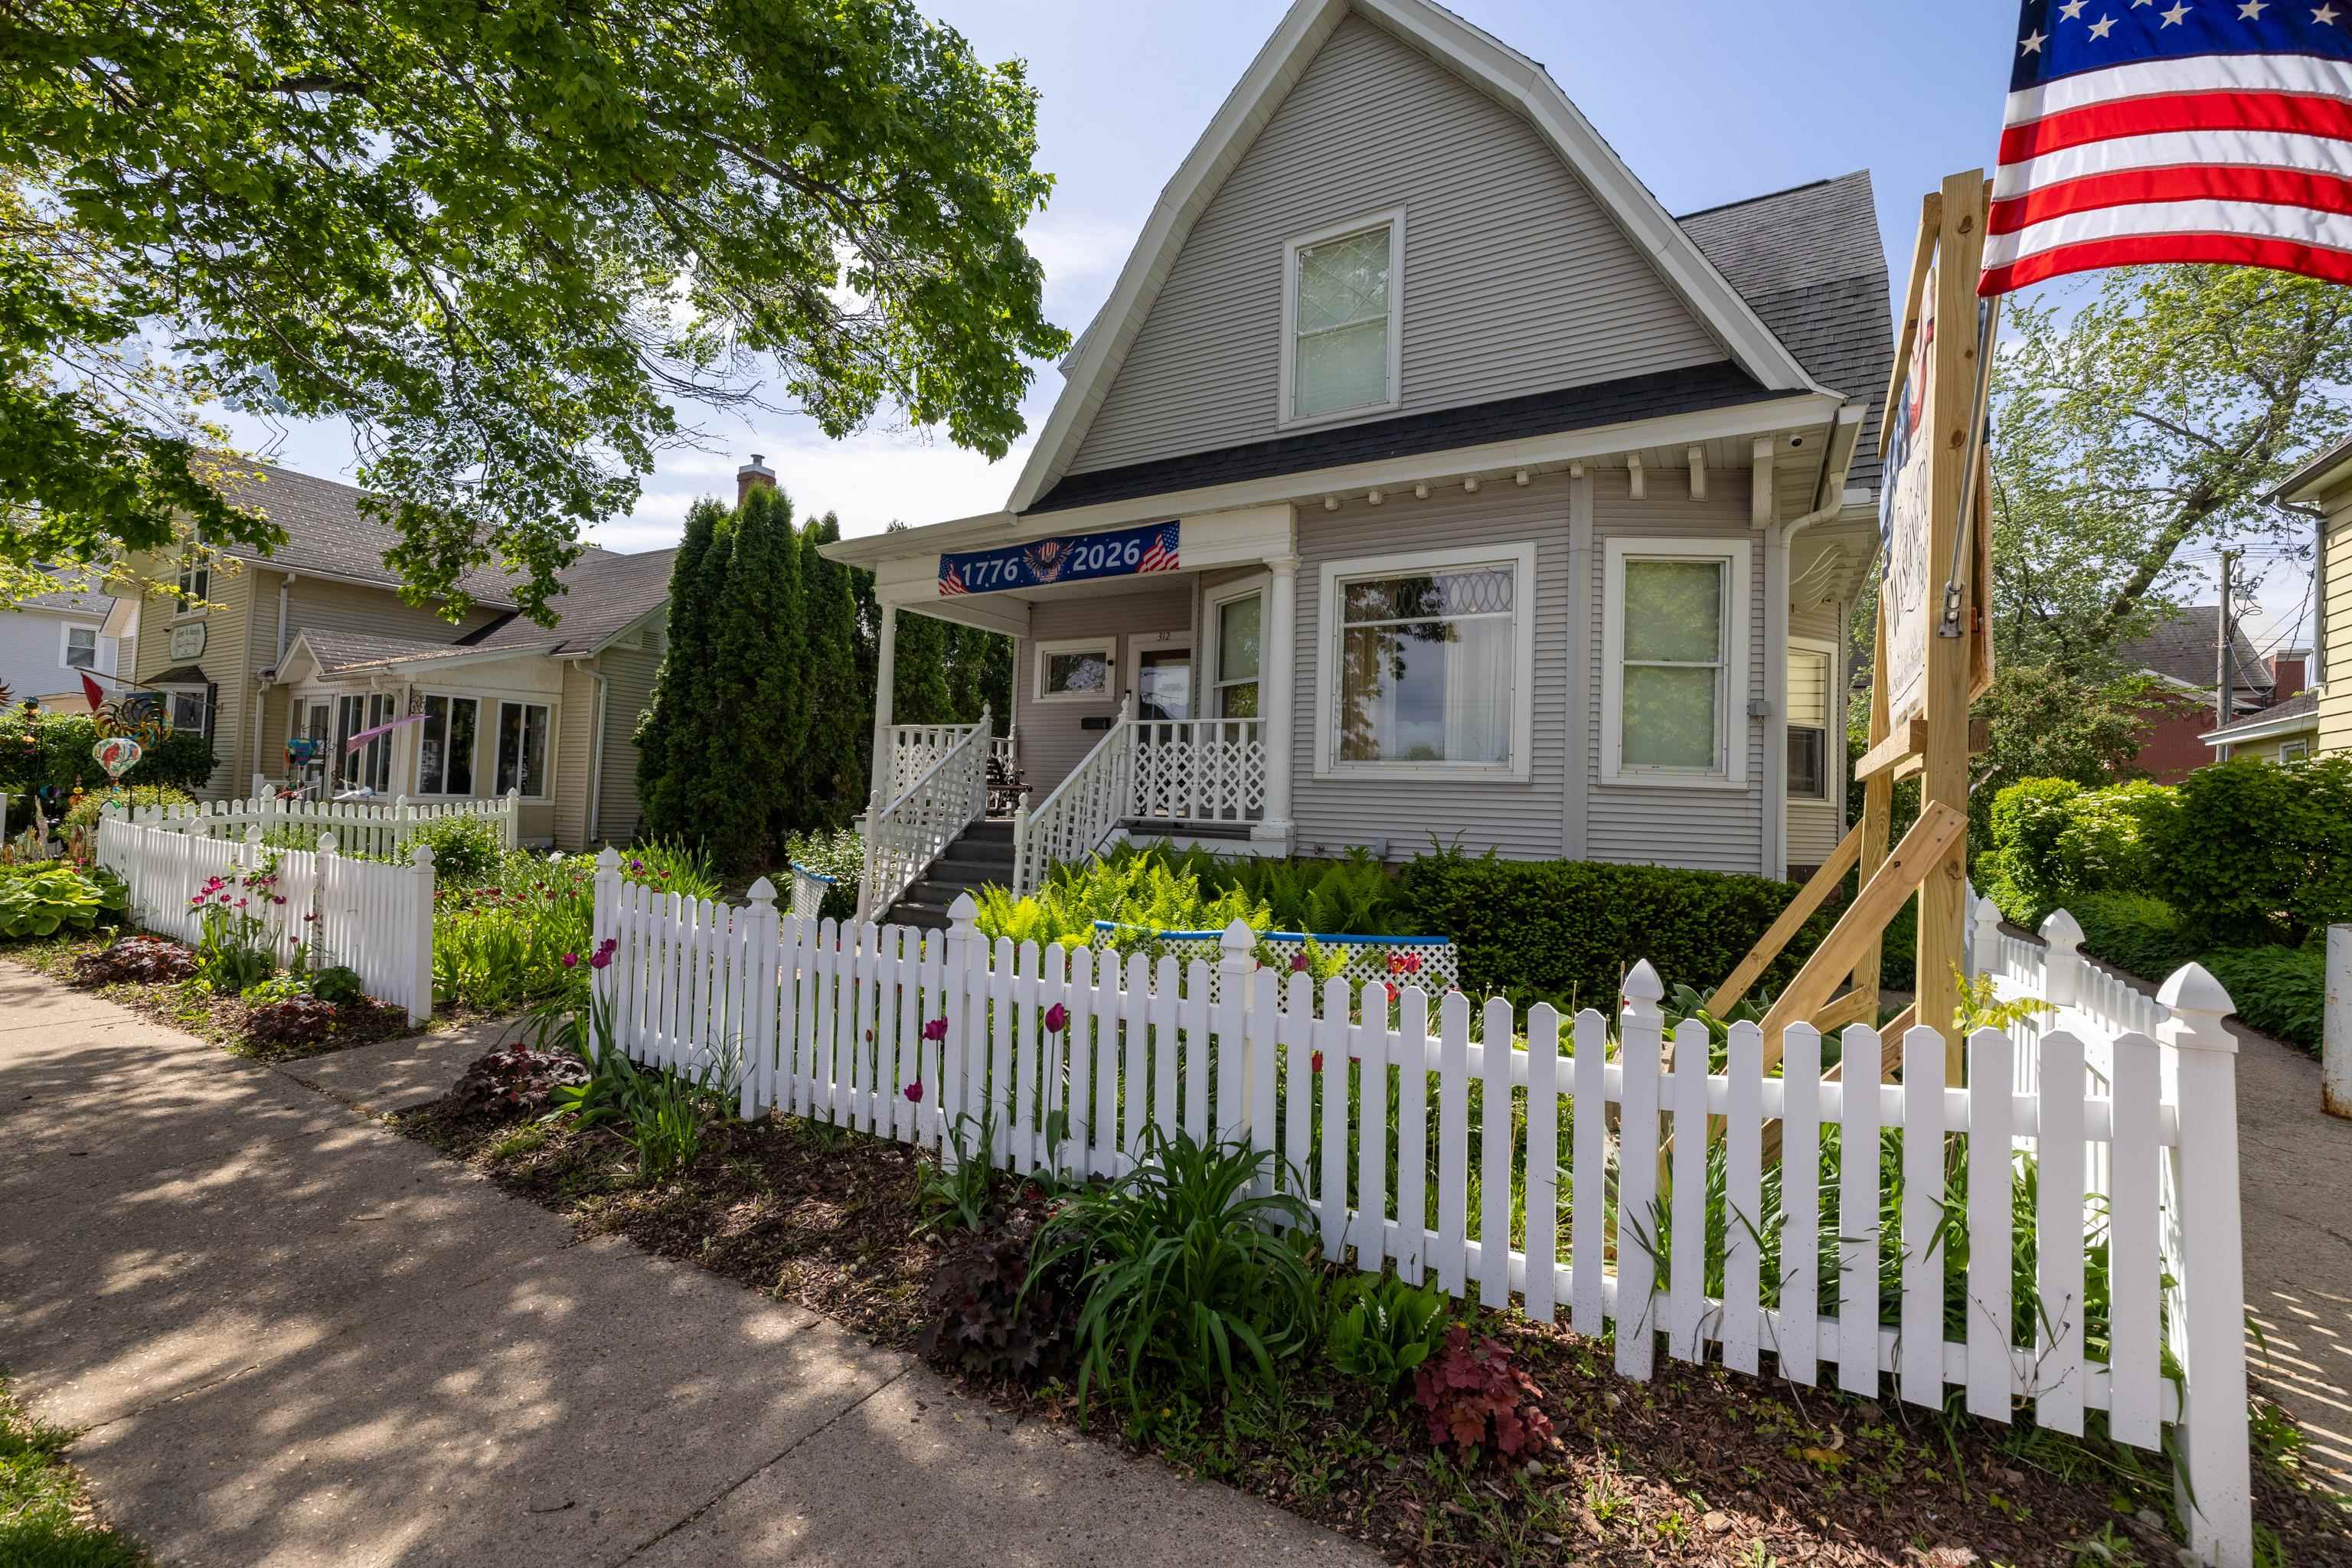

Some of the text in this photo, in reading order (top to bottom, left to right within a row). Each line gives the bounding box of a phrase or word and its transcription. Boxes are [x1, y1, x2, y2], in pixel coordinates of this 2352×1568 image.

[962, 539, 1141, 586] 1776 2026
[1157, 630, 1171, 642] 312
